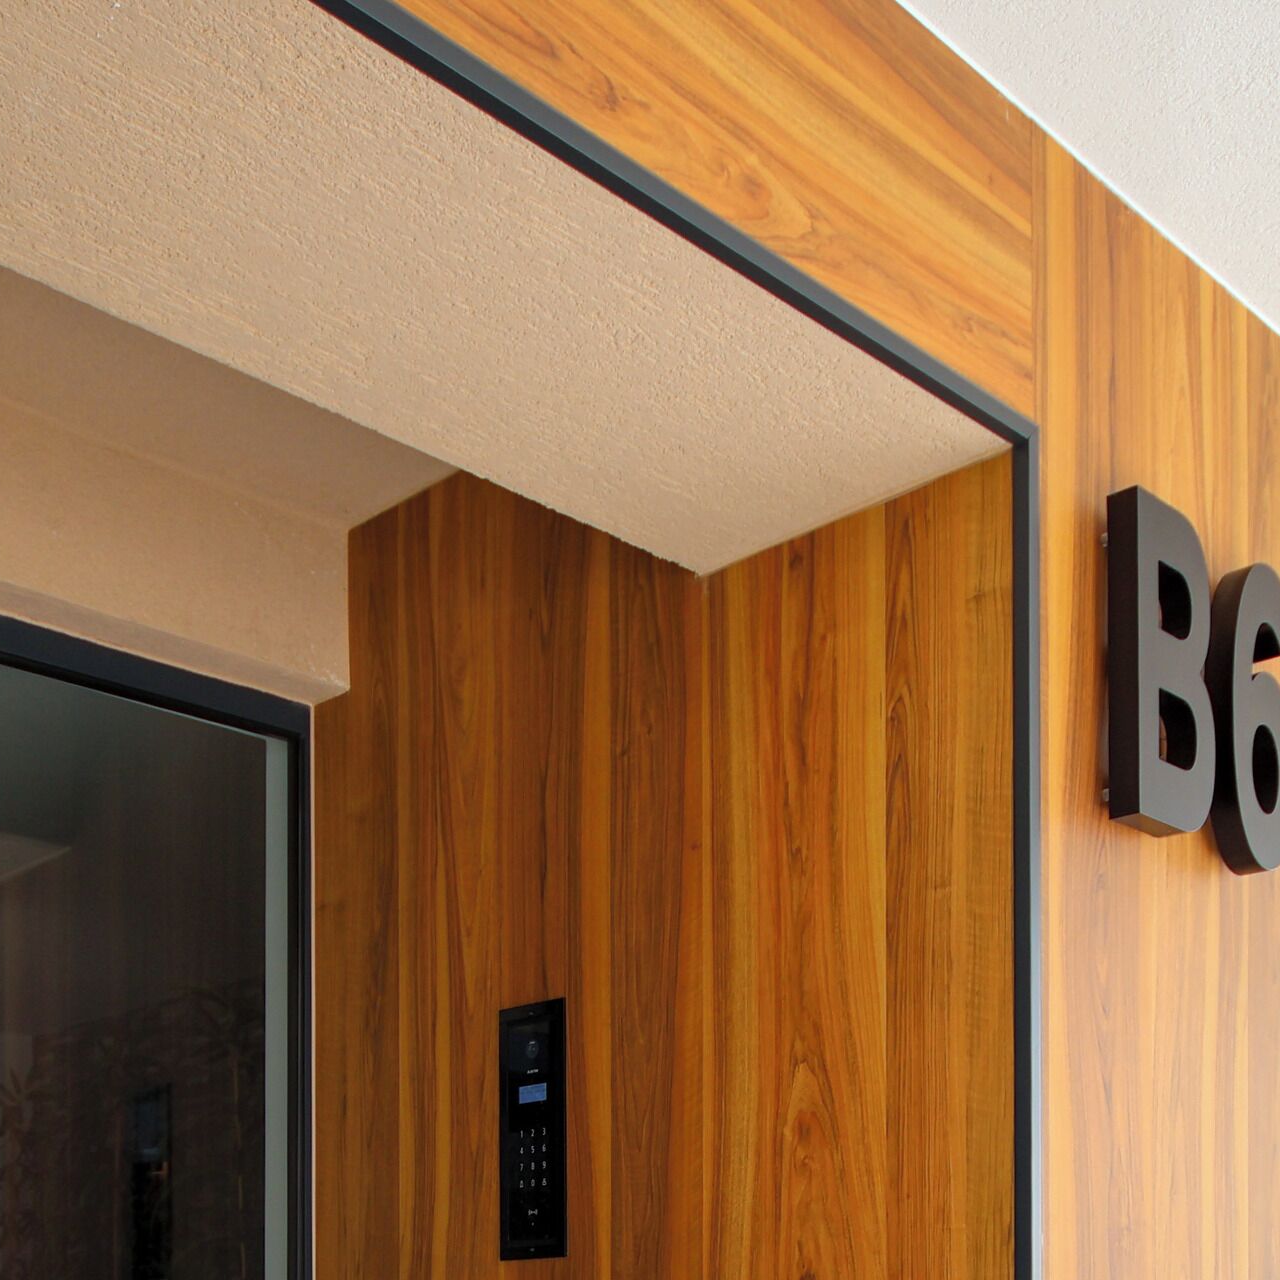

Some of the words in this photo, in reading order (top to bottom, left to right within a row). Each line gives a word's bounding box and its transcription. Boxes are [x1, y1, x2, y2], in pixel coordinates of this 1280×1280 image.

[520, 1130, 524, 1138] 1
[531, 1128, 535, 1137] 2
[542, 1127, 546, 1136] 3
[531, 1145, 535, 1154] 5
[542, 1143, 546, 1152] 6
[520, 1163, 524, 1171] 7
[531, 1161, 535, 1170] 8
[542, 1160, 547, 1169] 9
[531, 1179, 536, 1187] 0
